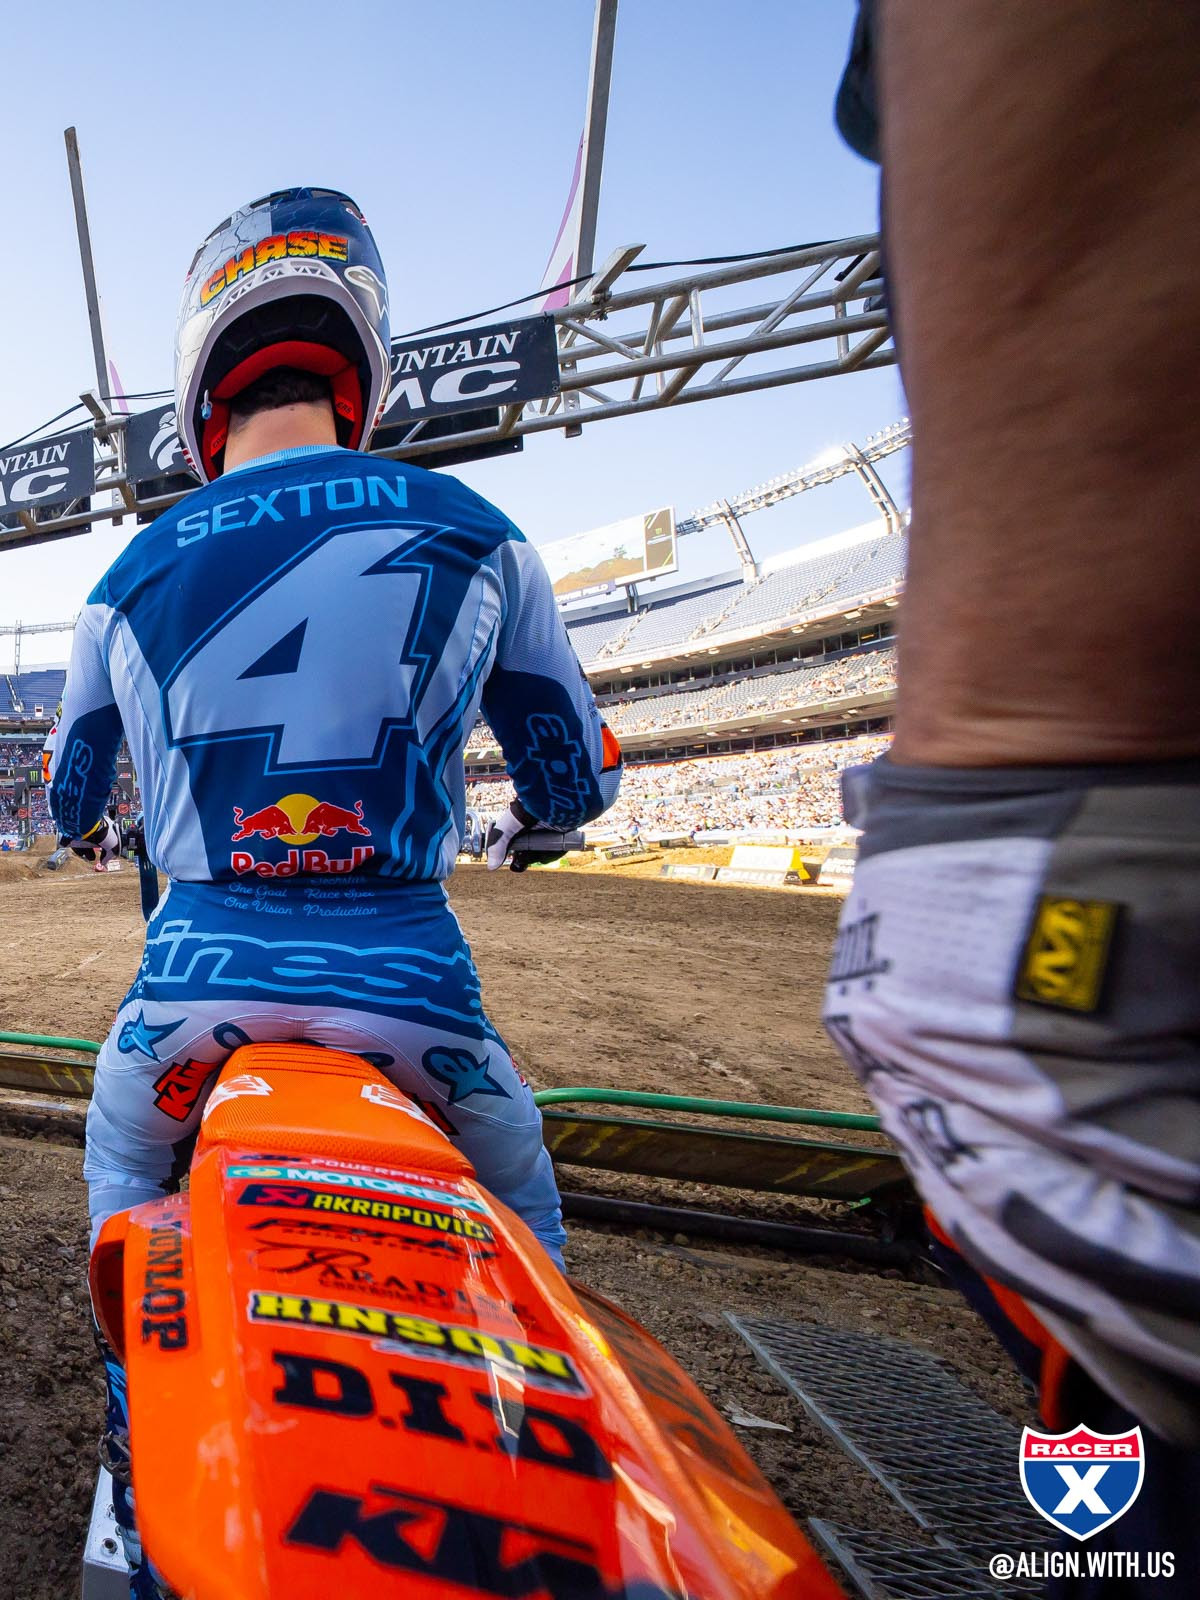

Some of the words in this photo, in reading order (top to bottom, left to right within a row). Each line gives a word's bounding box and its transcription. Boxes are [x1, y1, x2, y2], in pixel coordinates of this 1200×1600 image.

[200, 231, 349, 306] CHASE
[176, 475, 408, 548] SEXTON
[163, 521, 452, 774] 4
[231, 850, 299, 878] Red
[302, 846, 375, 874] Bull
[224, 897, 249, 910] One
[251, 900, 293, 915] Vision
[228, 882, 253, 895] One
[303, 903, 377, 917] Production
[287, 1168, 490, 1214] MOTOREX
[254, 1292, 572, 1378] HINSON
